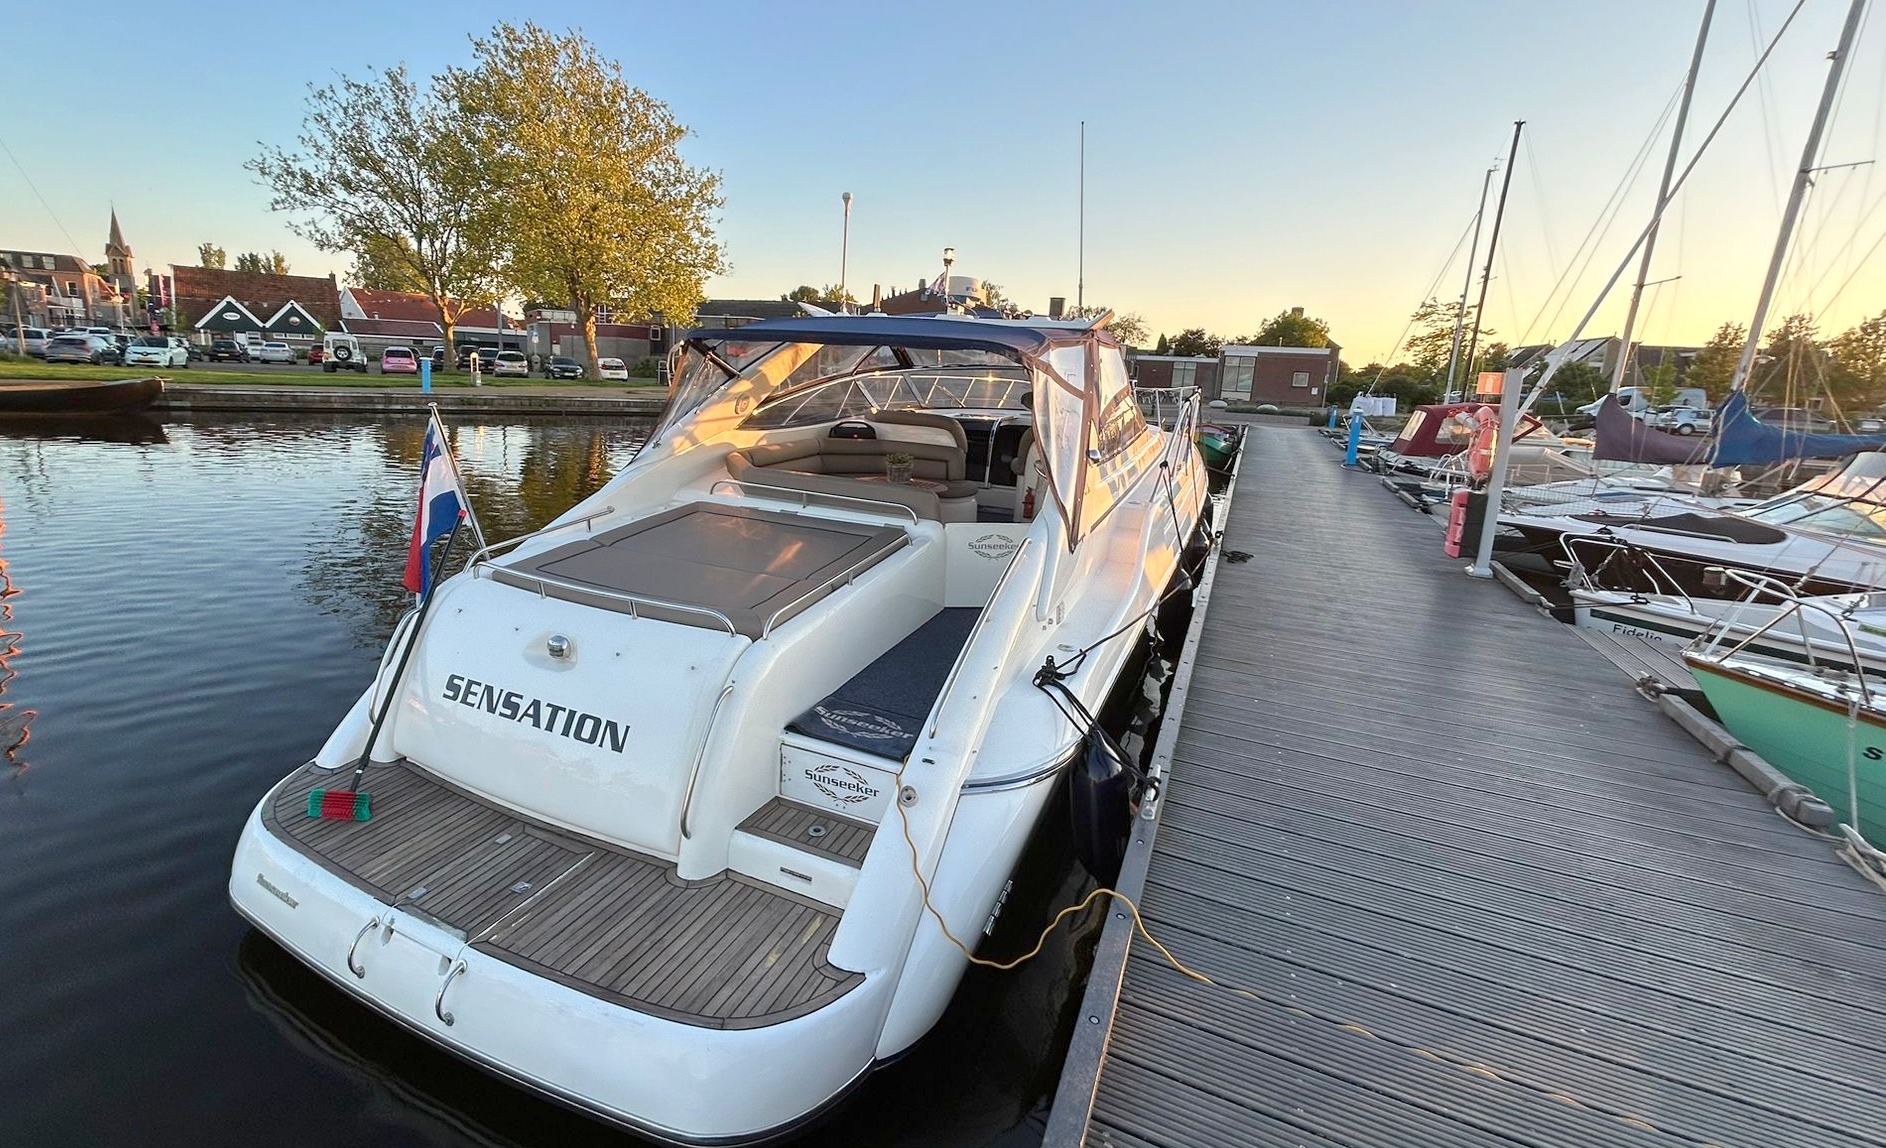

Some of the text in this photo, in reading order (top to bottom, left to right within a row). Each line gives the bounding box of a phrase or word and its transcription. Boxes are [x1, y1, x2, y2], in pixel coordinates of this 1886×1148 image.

[442, 673, 631, 754] SENSATION
[813, 705, 914, 739] Sunseeker
[804, 769, 880, 798] Sunseeker
